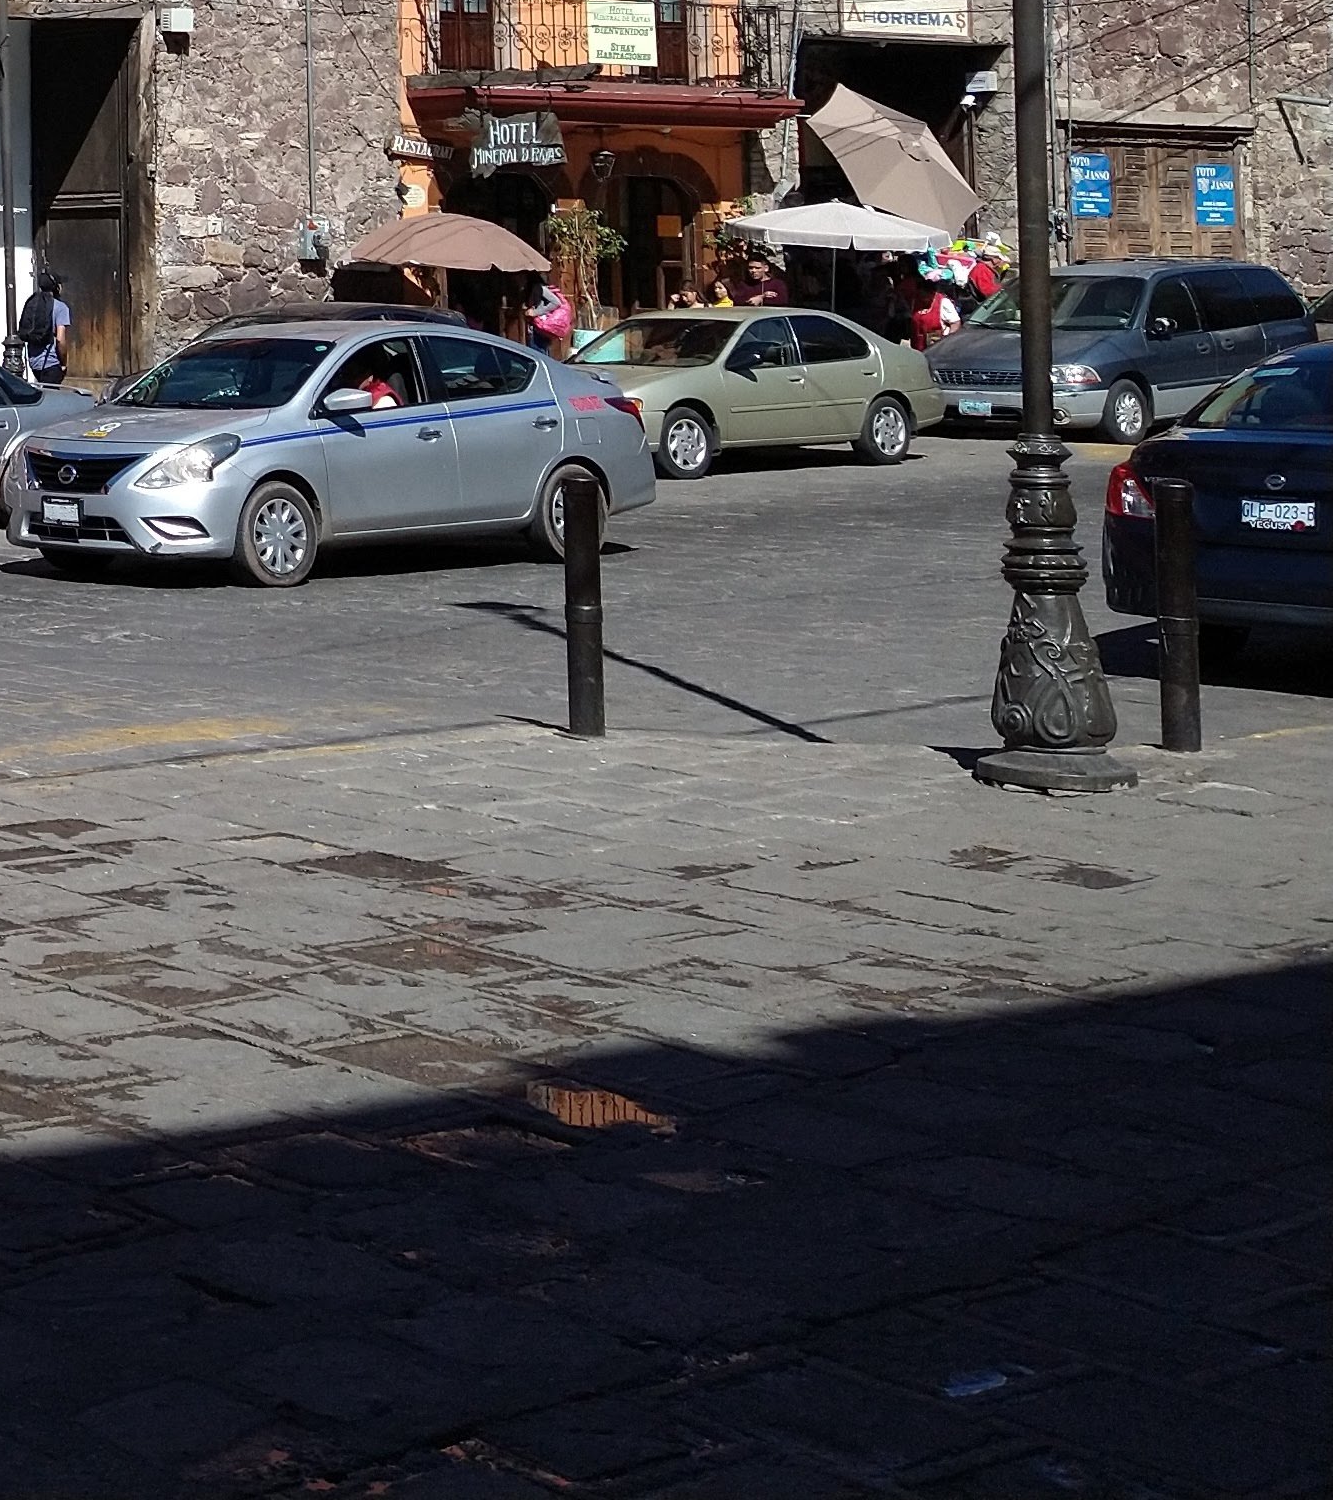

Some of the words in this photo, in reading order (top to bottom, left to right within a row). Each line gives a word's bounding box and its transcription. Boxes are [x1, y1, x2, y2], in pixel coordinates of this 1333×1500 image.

[489, 120, 543, 148] HOTEL
[472, 147, 518, 169] MINERAL
[1242, 502, 1315, 522] GLP-023-B
[1250, 520, 1293, 531] VEGUSA
